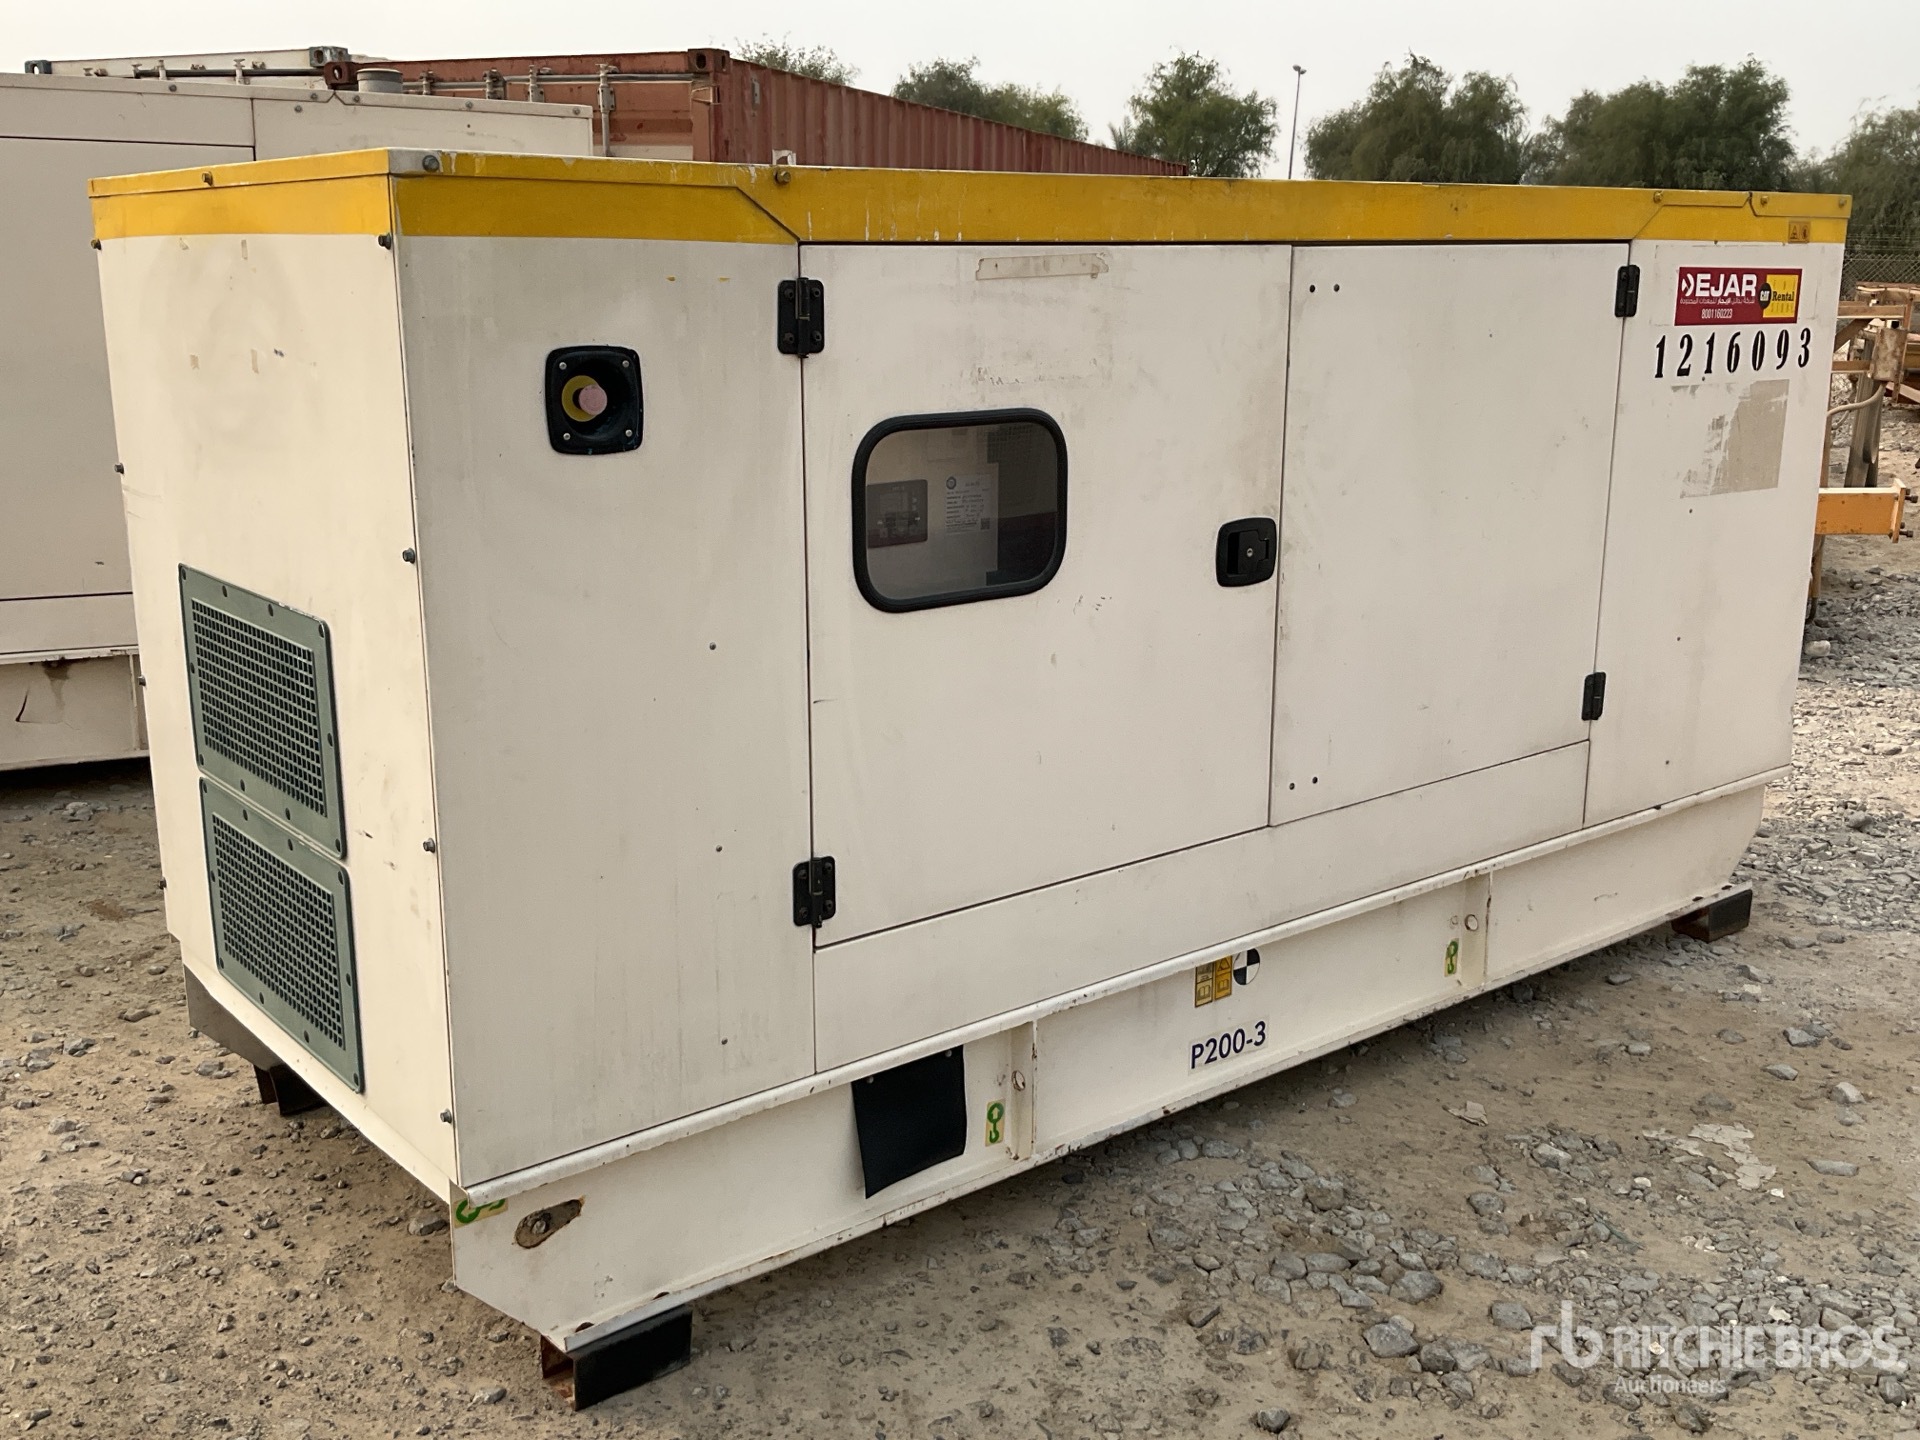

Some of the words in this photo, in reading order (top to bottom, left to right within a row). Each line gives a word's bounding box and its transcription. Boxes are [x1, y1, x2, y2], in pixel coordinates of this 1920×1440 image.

[1696, 273, 1758, 297] EJAR
[1772, 291, 1795, 302] Rental
[1701, 308, 1733, 319] 8001160223
[1654, 327, 1811, 379] 1216093
[1191, 1020, 1266, 1070] P200-3
